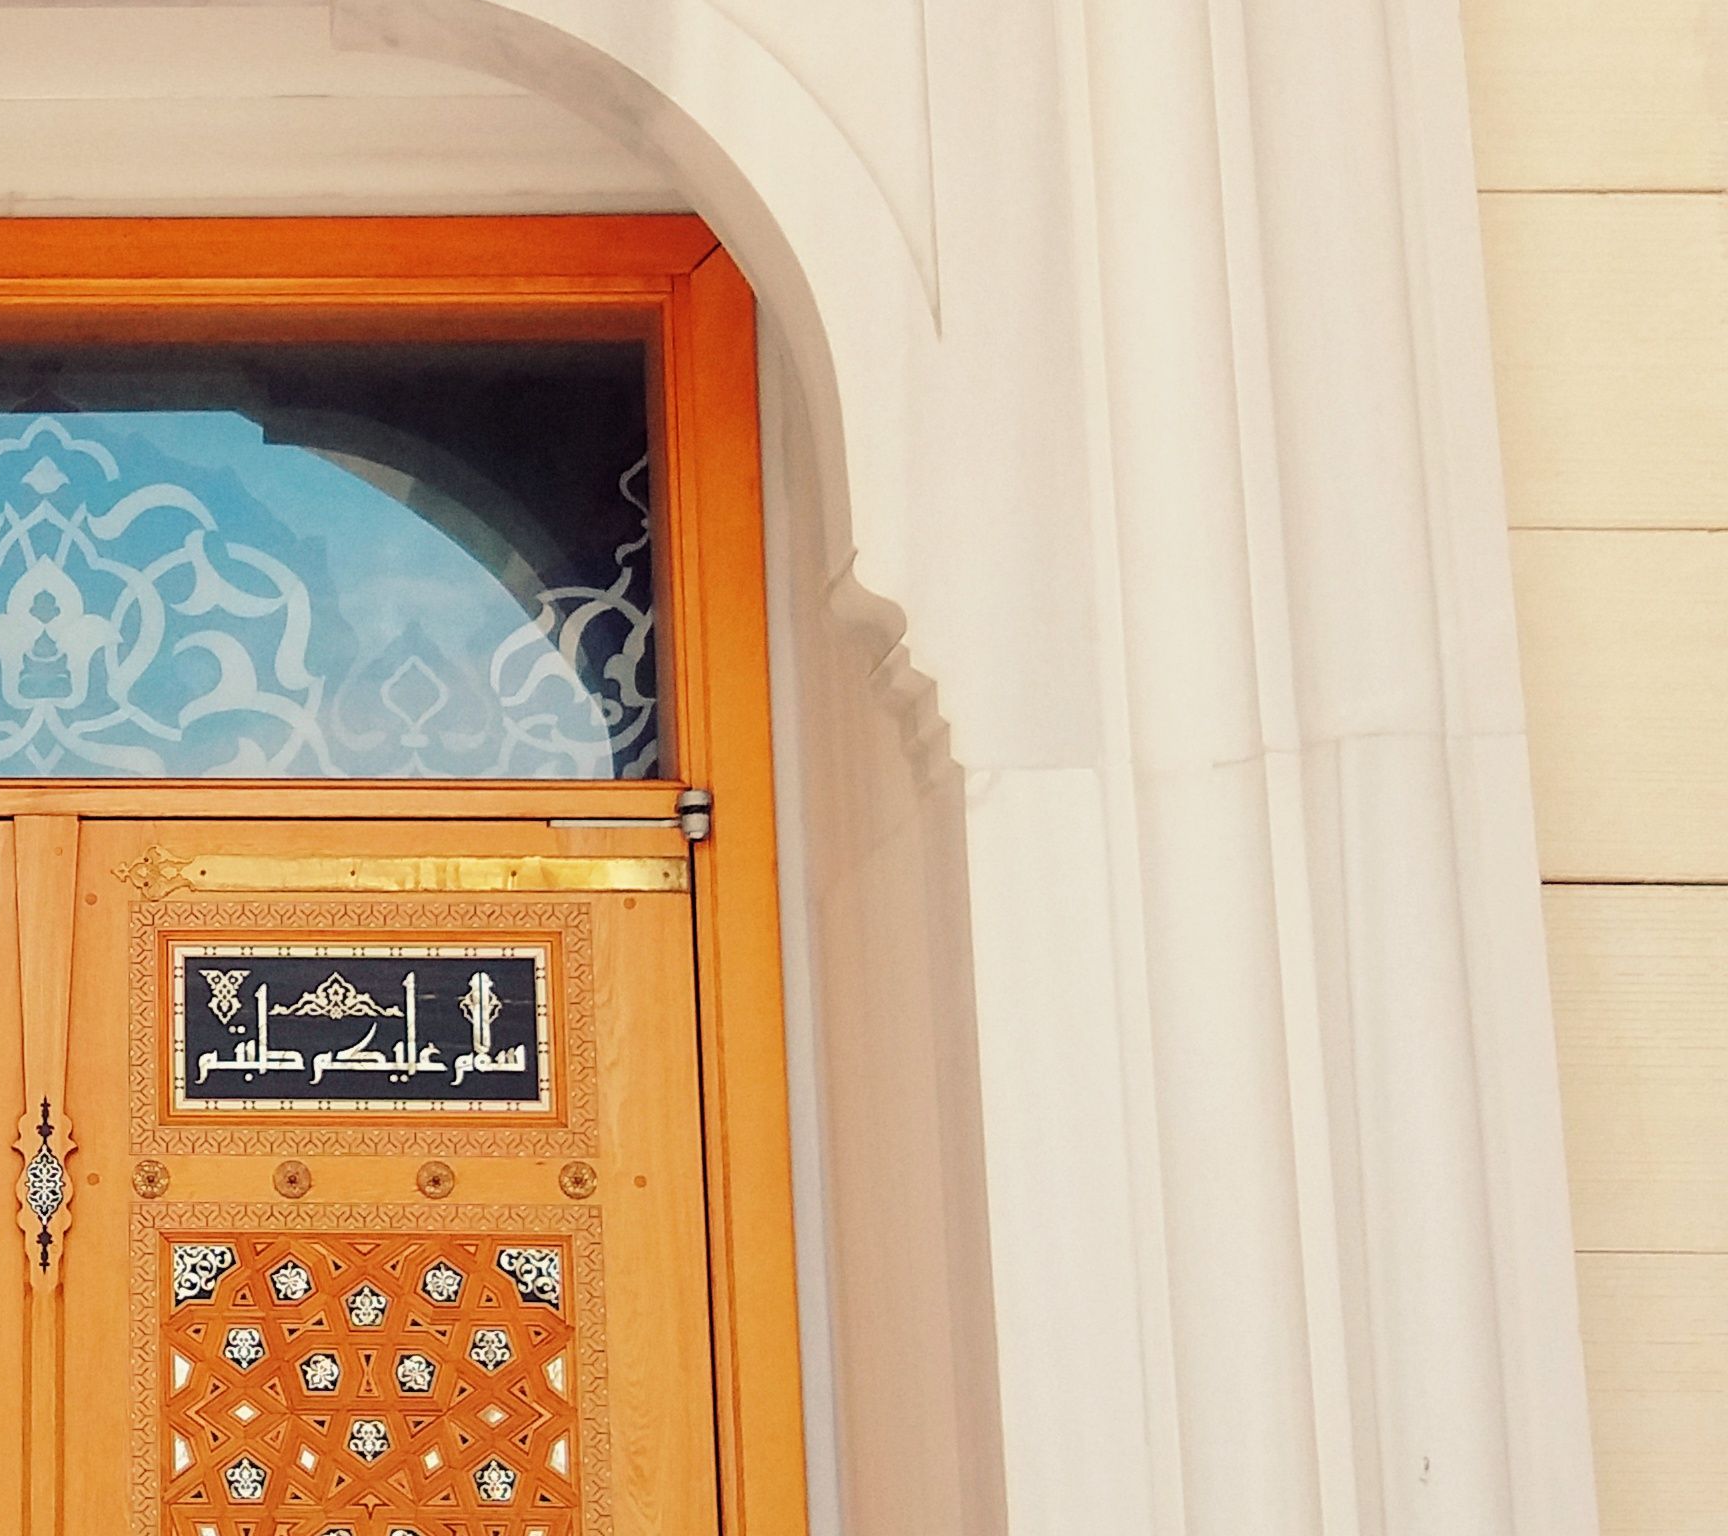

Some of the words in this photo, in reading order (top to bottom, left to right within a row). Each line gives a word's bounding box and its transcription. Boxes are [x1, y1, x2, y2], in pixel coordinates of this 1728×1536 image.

[194, 983, 306, 1084] طبتم
[309, 971, 448, 1085] عليكم
[450, 971, 526, 1086] سلام
